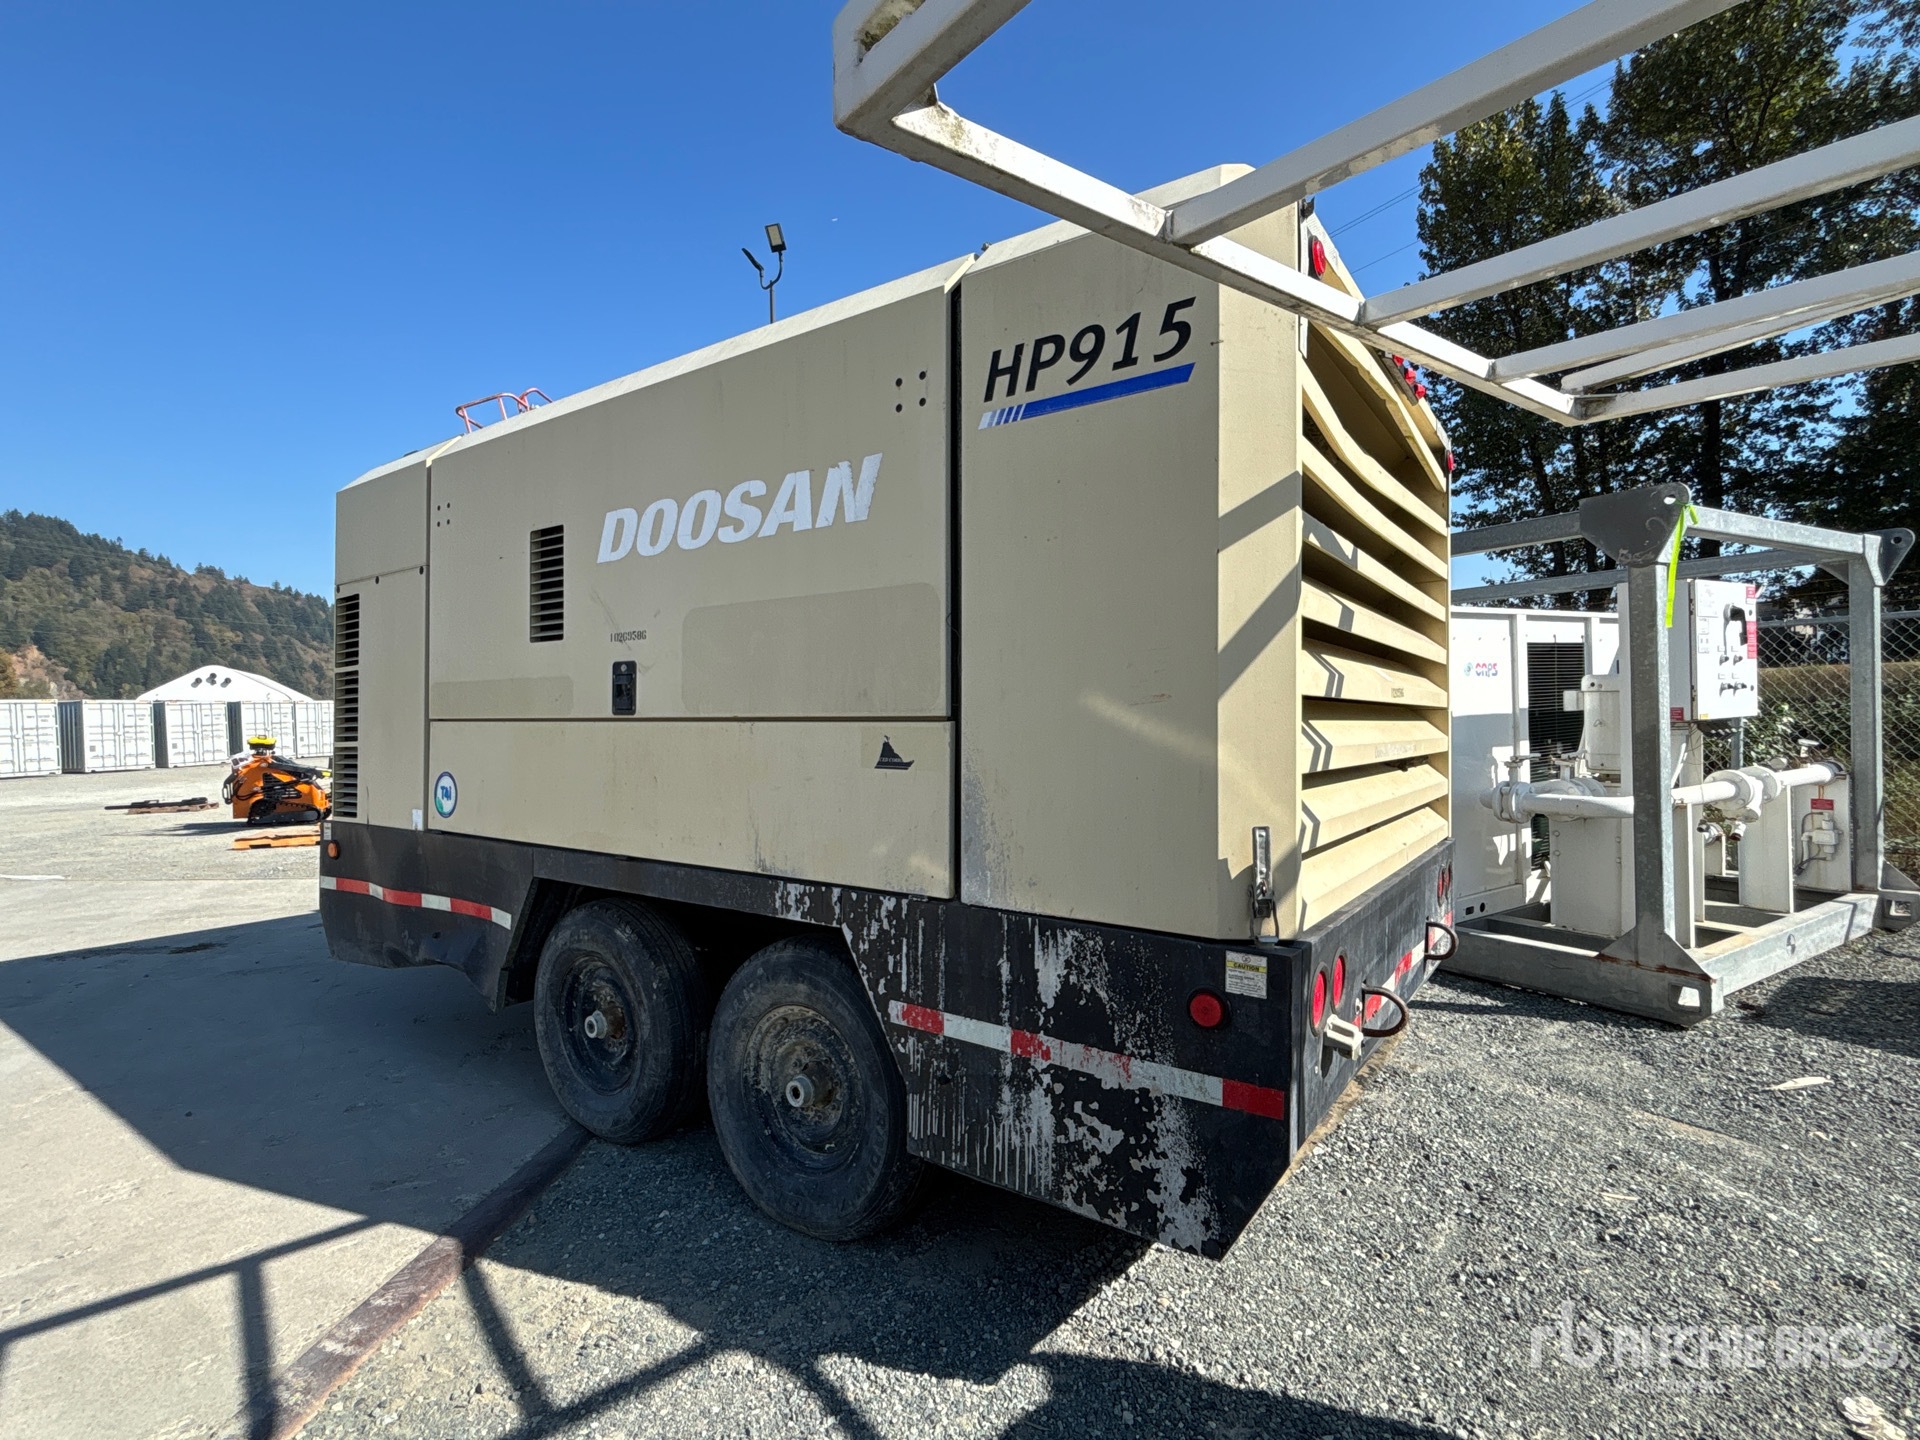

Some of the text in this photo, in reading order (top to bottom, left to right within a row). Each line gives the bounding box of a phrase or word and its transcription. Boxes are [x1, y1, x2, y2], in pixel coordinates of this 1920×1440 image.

[983, 296, 1197, 403] HP915
[596, 452, 883, 565] DOOSAN
[1233, 962, 1260, 973] CAUTION
